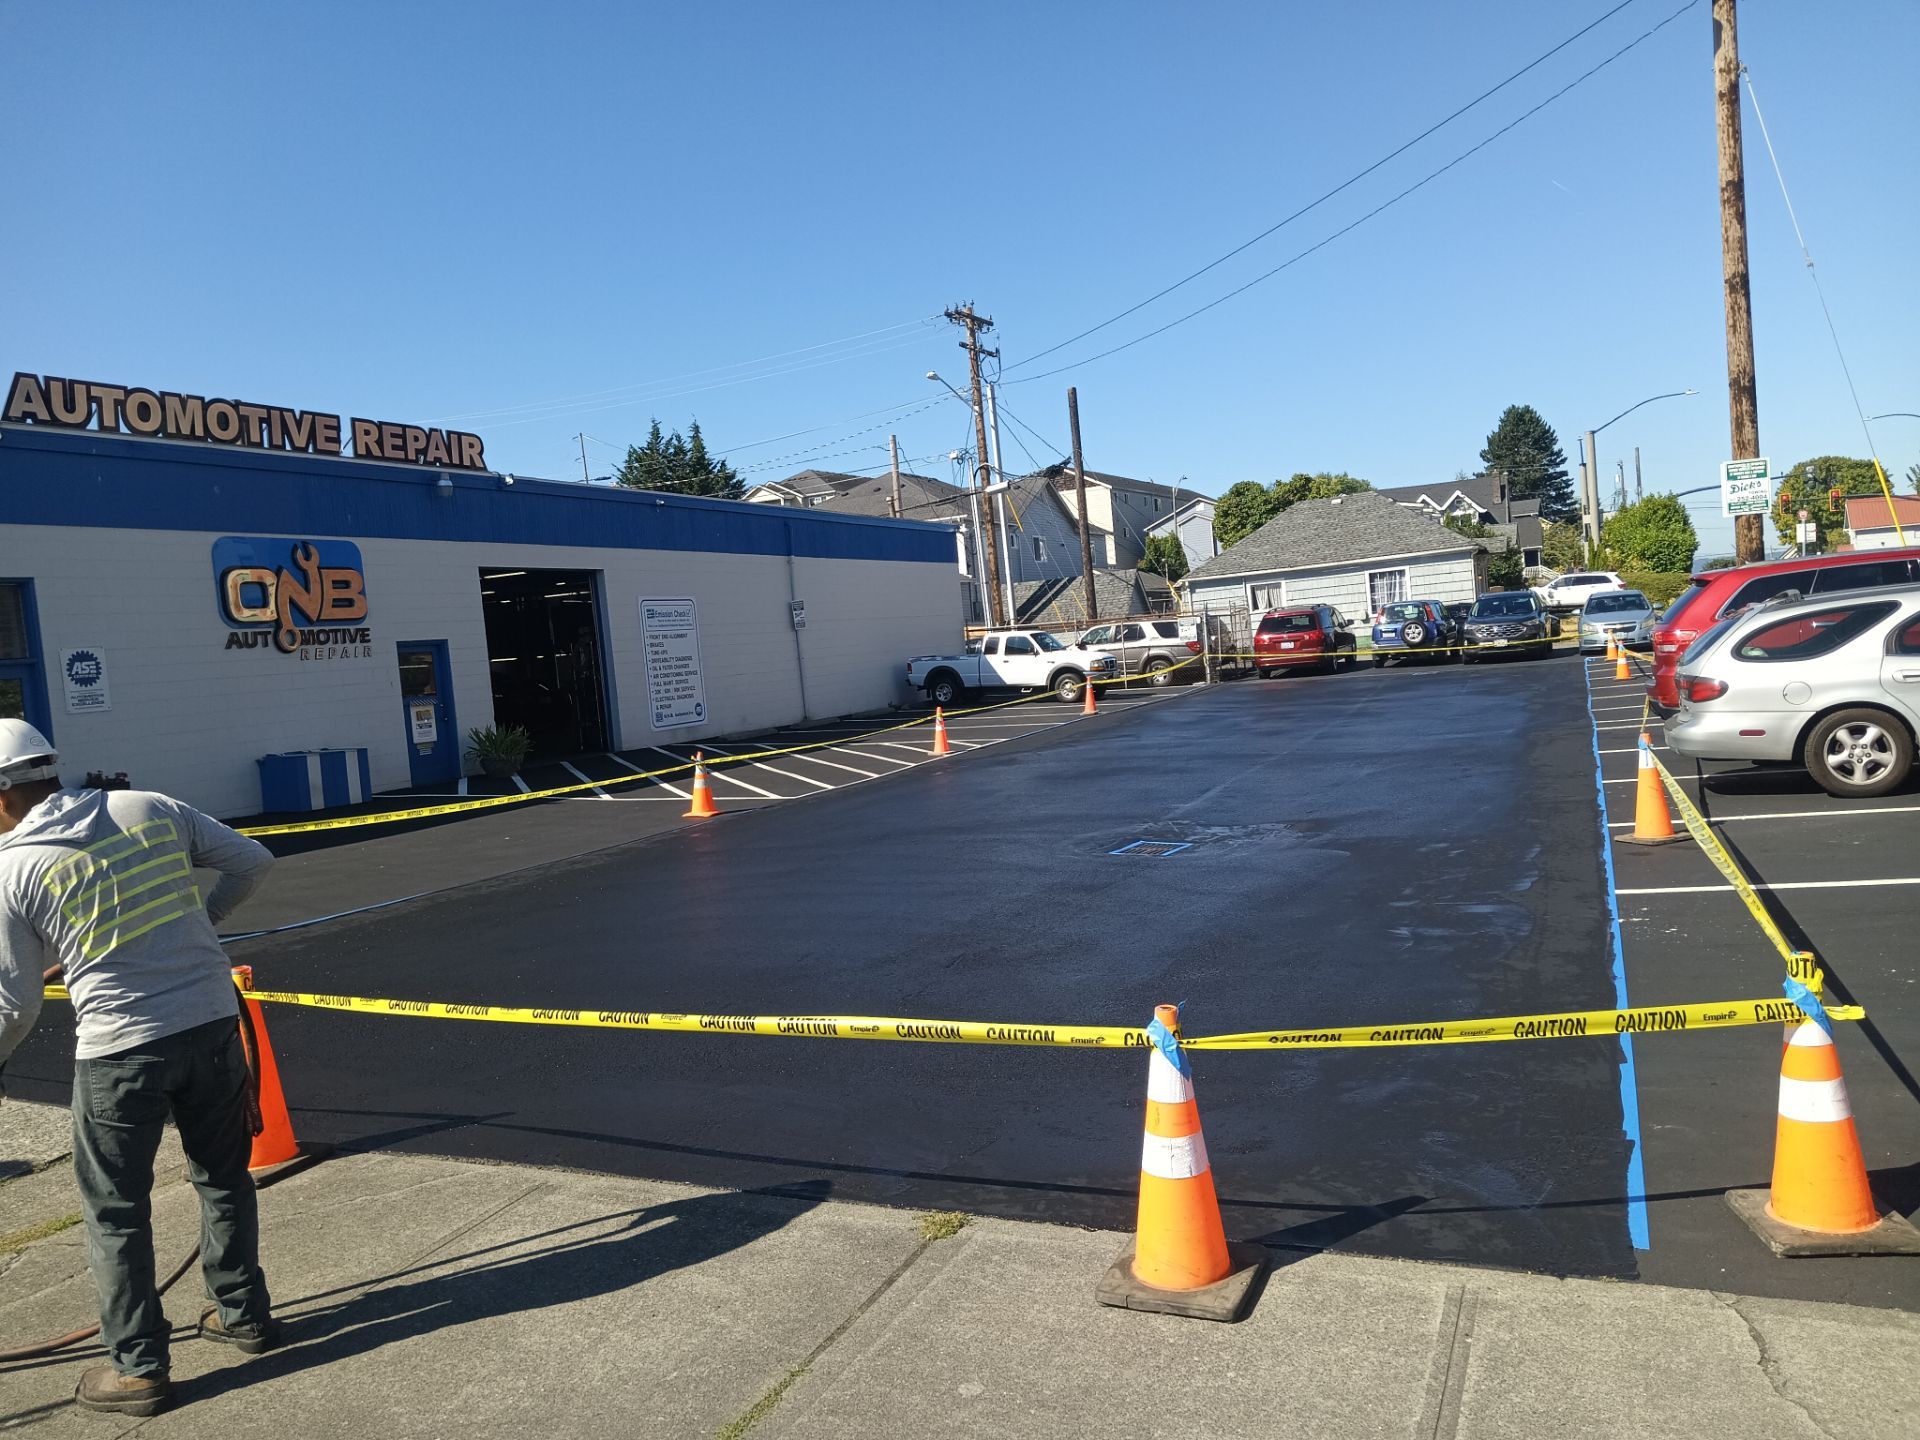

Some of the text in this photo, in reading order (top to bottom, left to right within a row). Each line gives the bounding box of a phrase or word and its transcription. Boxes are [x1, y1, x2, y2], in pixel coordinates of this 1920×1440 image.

[3, 373, 487, 470] AUTOMOTIVE REPAIR
[1729, 481, 1761, 495] Dick's
[300, 646, 372, 661] REPAIR
[71, 661, 97, 675] ASE
[388, 1000, 430, 1012] CAUTION
[445, 1003, 490, 1016] CAUTION
[532, 1009, 580, 1021] CAUTION
[598, 1011, 650, 1025] CAUTION
[699, 1014, 757, 1032] CAUTION
[777, 1017, 839, 1036] CAUTION
[896, 1023, 963, 1040] CAUTION
[986, 1027, 1056, 1043] CAUTION
[1369, 1027, 1445, 1042] CAUTION
[1513, 1016, 1588, 1038] CAUTION
[1614, 1010, 1687, 1033] CAUTION
[1703, 1011, 1738, 1023] Empire
[1754, 1002, 1808, 1023] CAUTI
